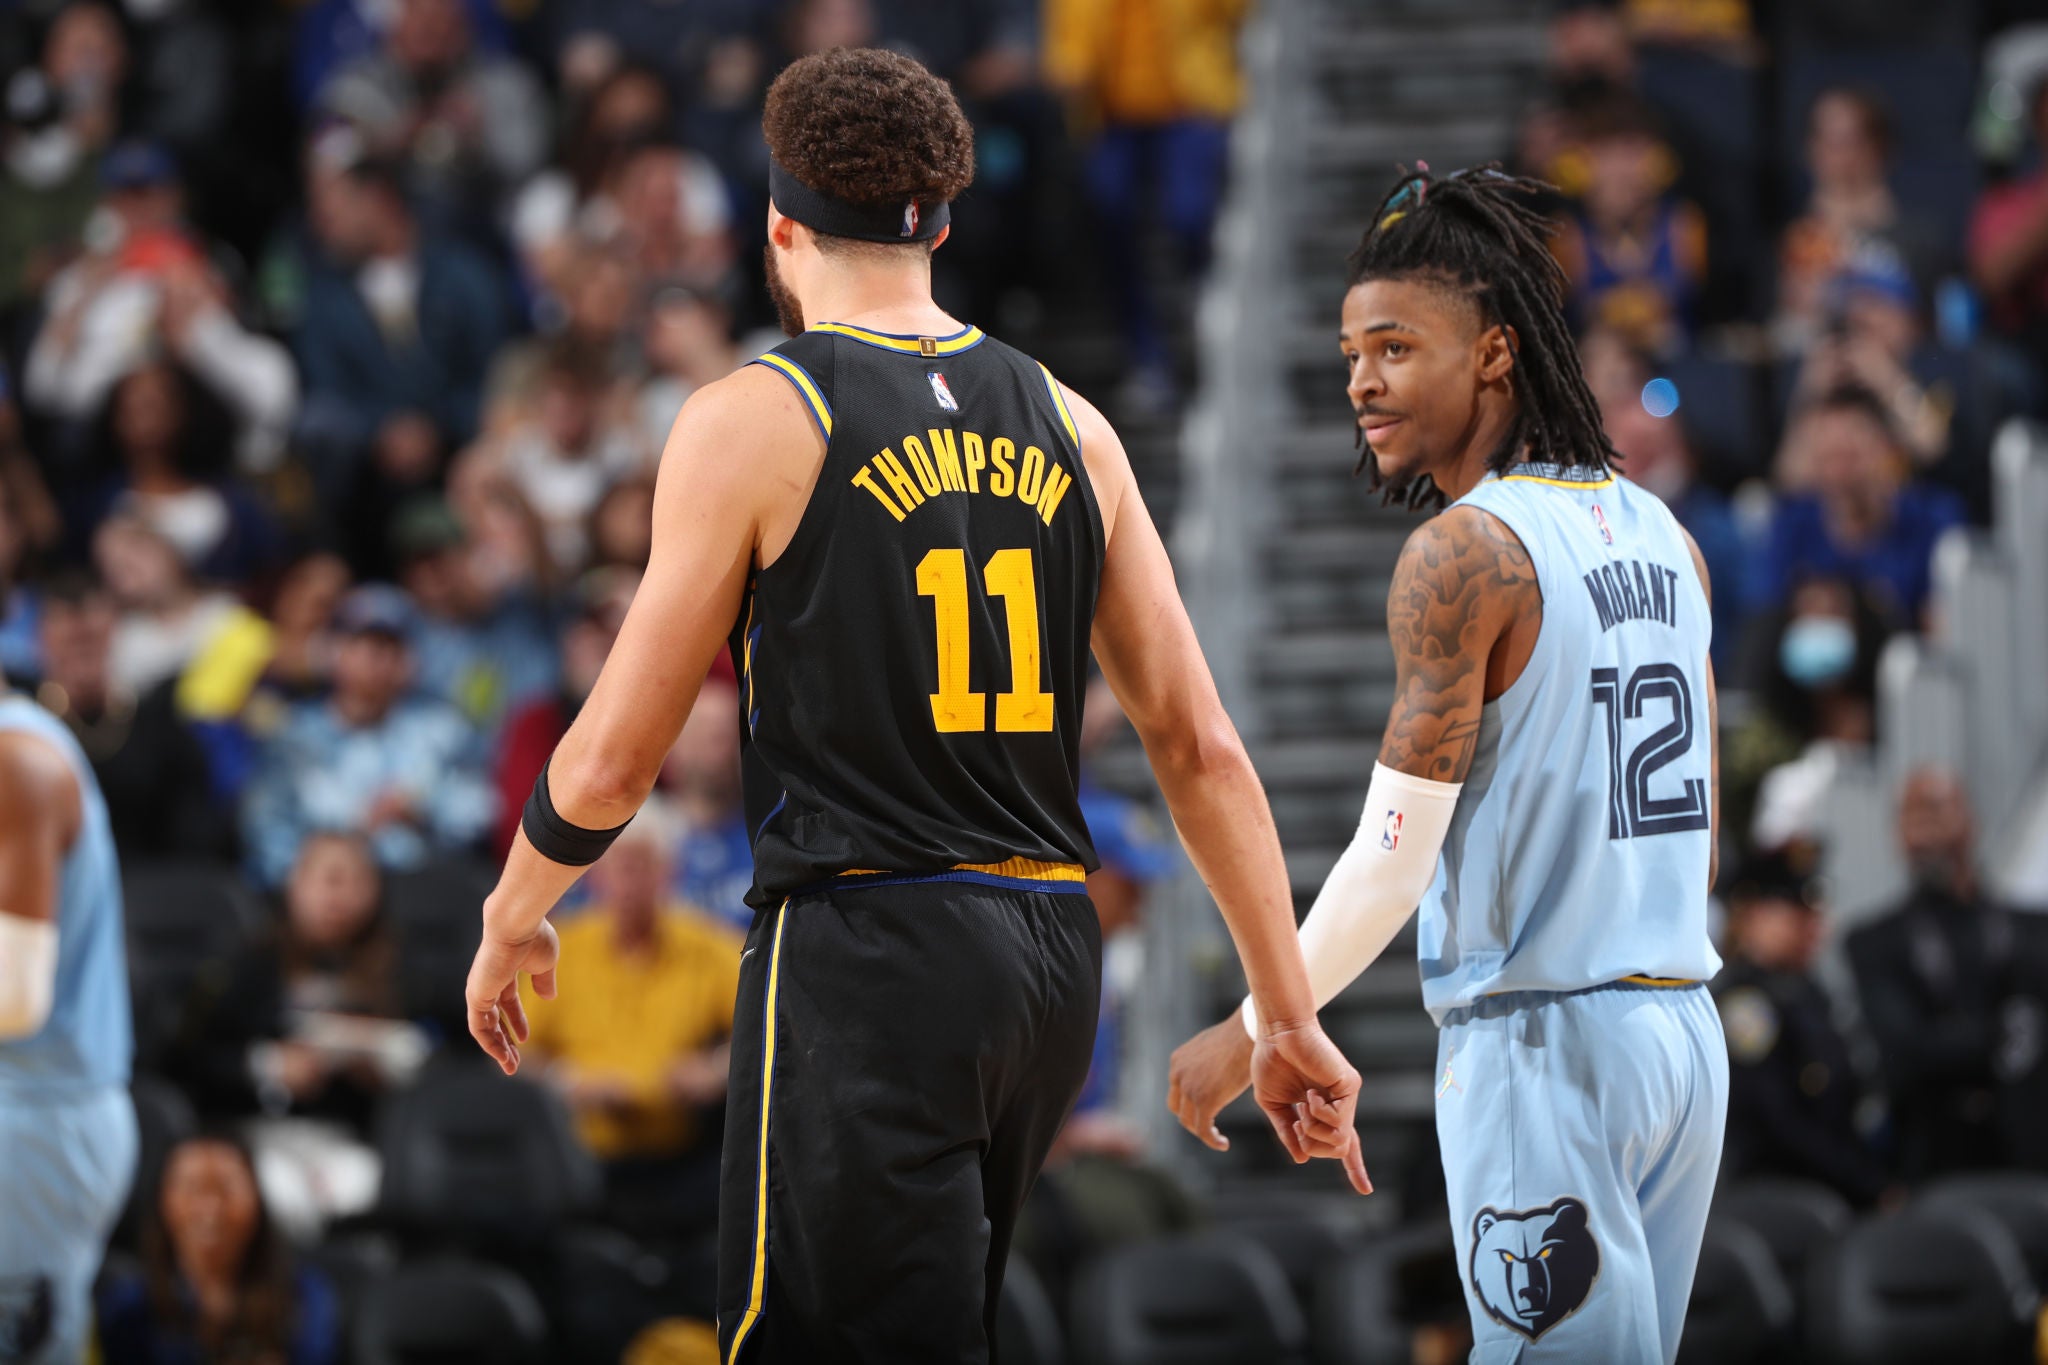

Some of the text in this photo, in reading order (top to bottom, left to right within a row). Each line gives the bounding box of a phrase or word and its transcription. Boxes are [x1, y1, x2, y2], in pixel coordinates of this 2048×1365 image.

[851, 429, 1072, 527] THOMPSON
[916, 548, 1054, 732] 11
[1583, 560, 1678, 633] MORANT
[1591, 663, 1709, 840] 12
